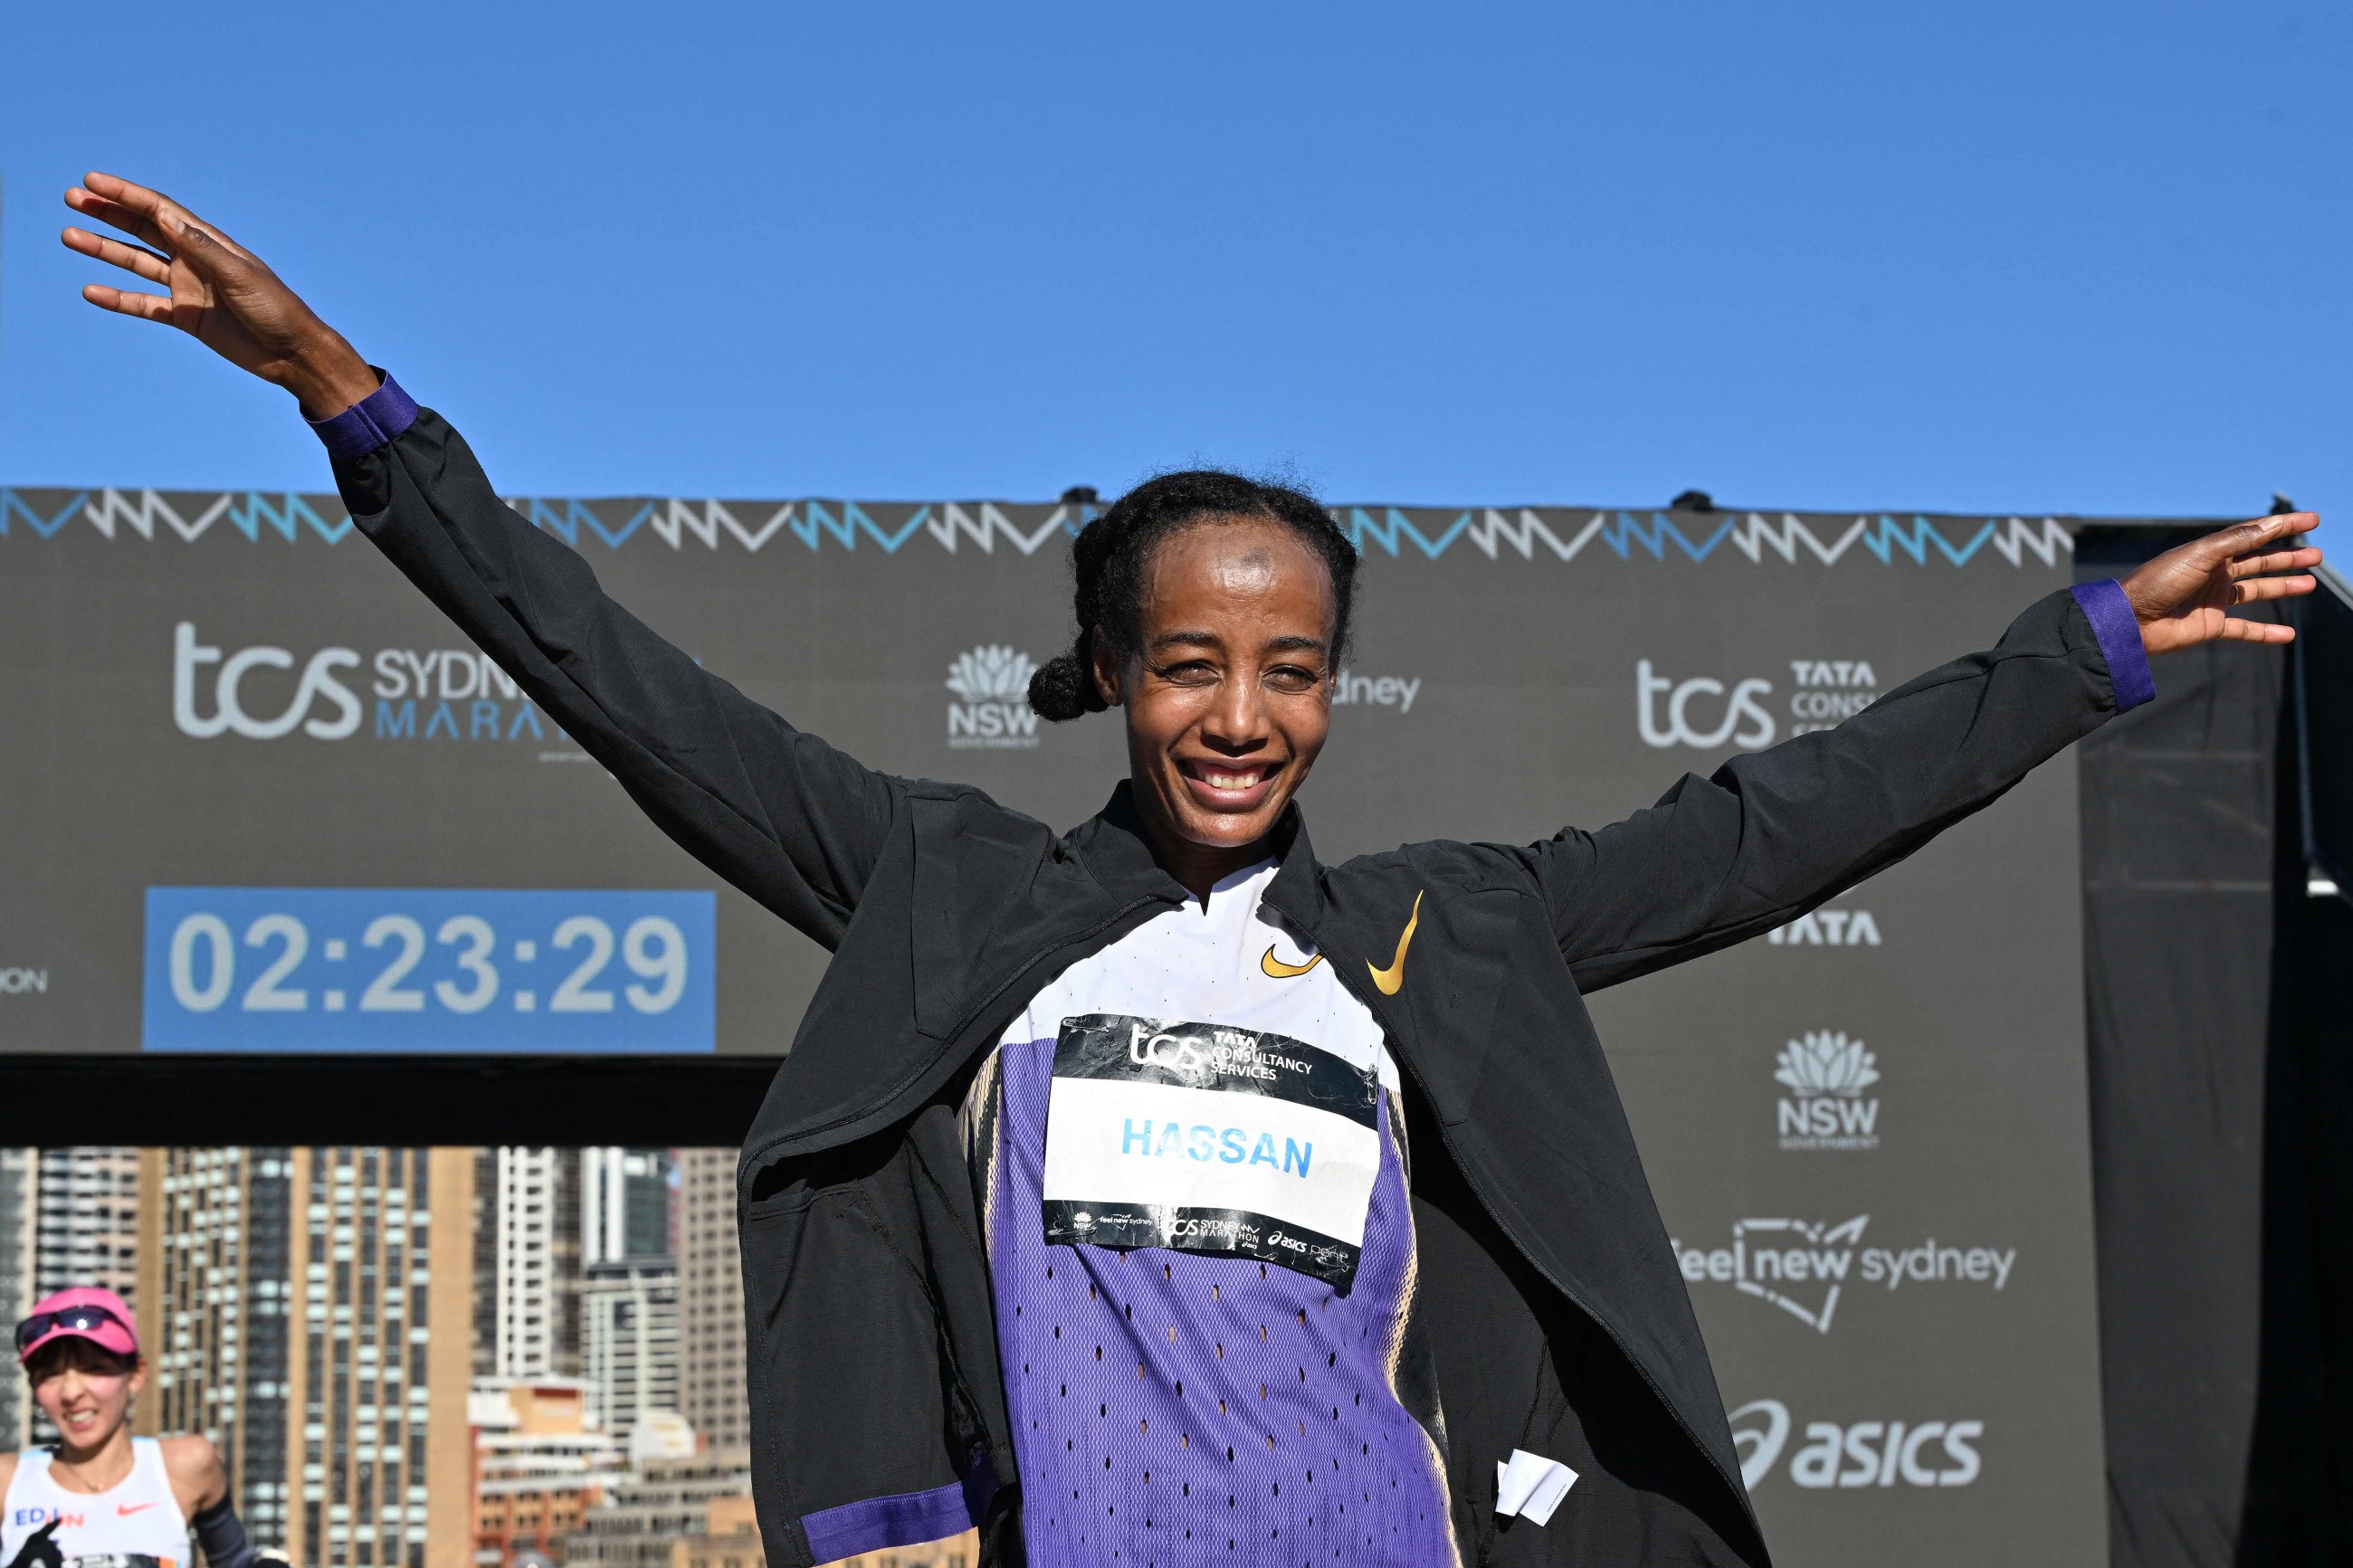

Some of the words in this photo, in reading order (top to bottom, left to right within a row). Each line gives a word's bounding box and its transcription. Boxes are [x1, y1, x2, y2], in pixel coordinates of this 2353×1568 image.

[373, 650, 532, 698] SYDN
[1790, 660, 1877, 688] TATA
[1331, 668, 1422, 714] dney
[1791, 690, 1877, 718] CONS
[375, 698, 568, 740] MARA
[947, 703, 1039, 736] NSW
[169, 913, 688, 1015] 02:23:29
[1213, 1031, 1257, 1049] TATA
[1211, 1061, 1277, 1081] SERVICES
[1212, 1046, 1313, 1075] CONSULTANCY
[1777, 1098, 1881, 1136] NSW
[1121, 1117, 1313, 1179] HASSAN
[1100, 1216, 1113, 1224] feel
[1129, 1217, 1153, 1226] sydney
[1200, 1219, 1241, 1231] SYDNEY
[1200, 1228, 1260, 1244] MARATHON
[1753, 1249, 1853, 1282] new
[1861, 1238, 2017, 1291] sydney
